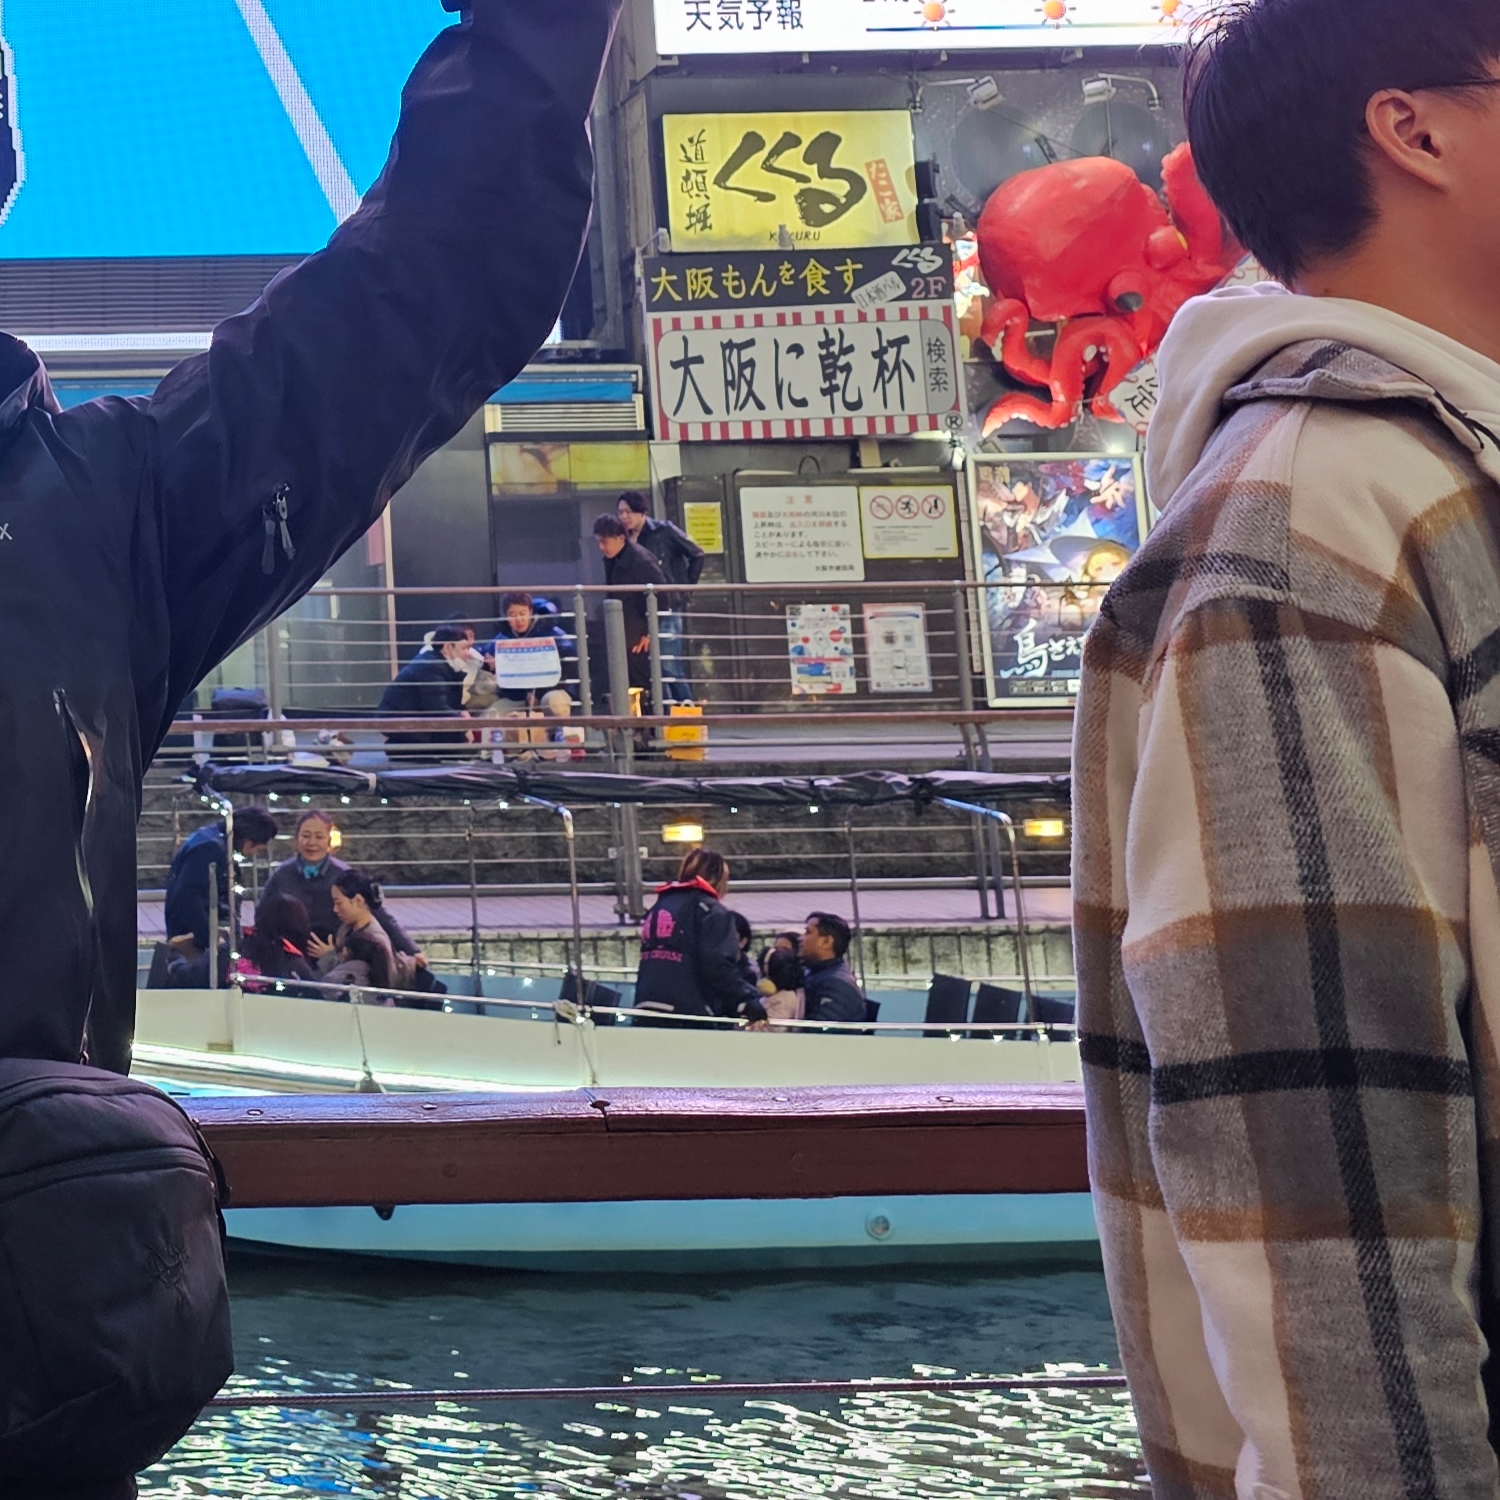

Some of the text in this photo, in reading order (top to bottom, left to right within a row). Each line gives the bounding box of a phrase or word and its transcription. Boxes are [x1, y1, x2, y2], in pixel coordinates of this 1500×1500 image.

[679, 128, 714, 235] 道頓堀
[712, 130, 868, 228] くくる
[651, 257, 864, 303] 大阪もんを食す
[891, 246, 944, 274] くくる
[910, 276, 947, 299] 2F
[669, 326, 916, 418] 大阪に乾杯
[926, 337, 950, 394] 検索
